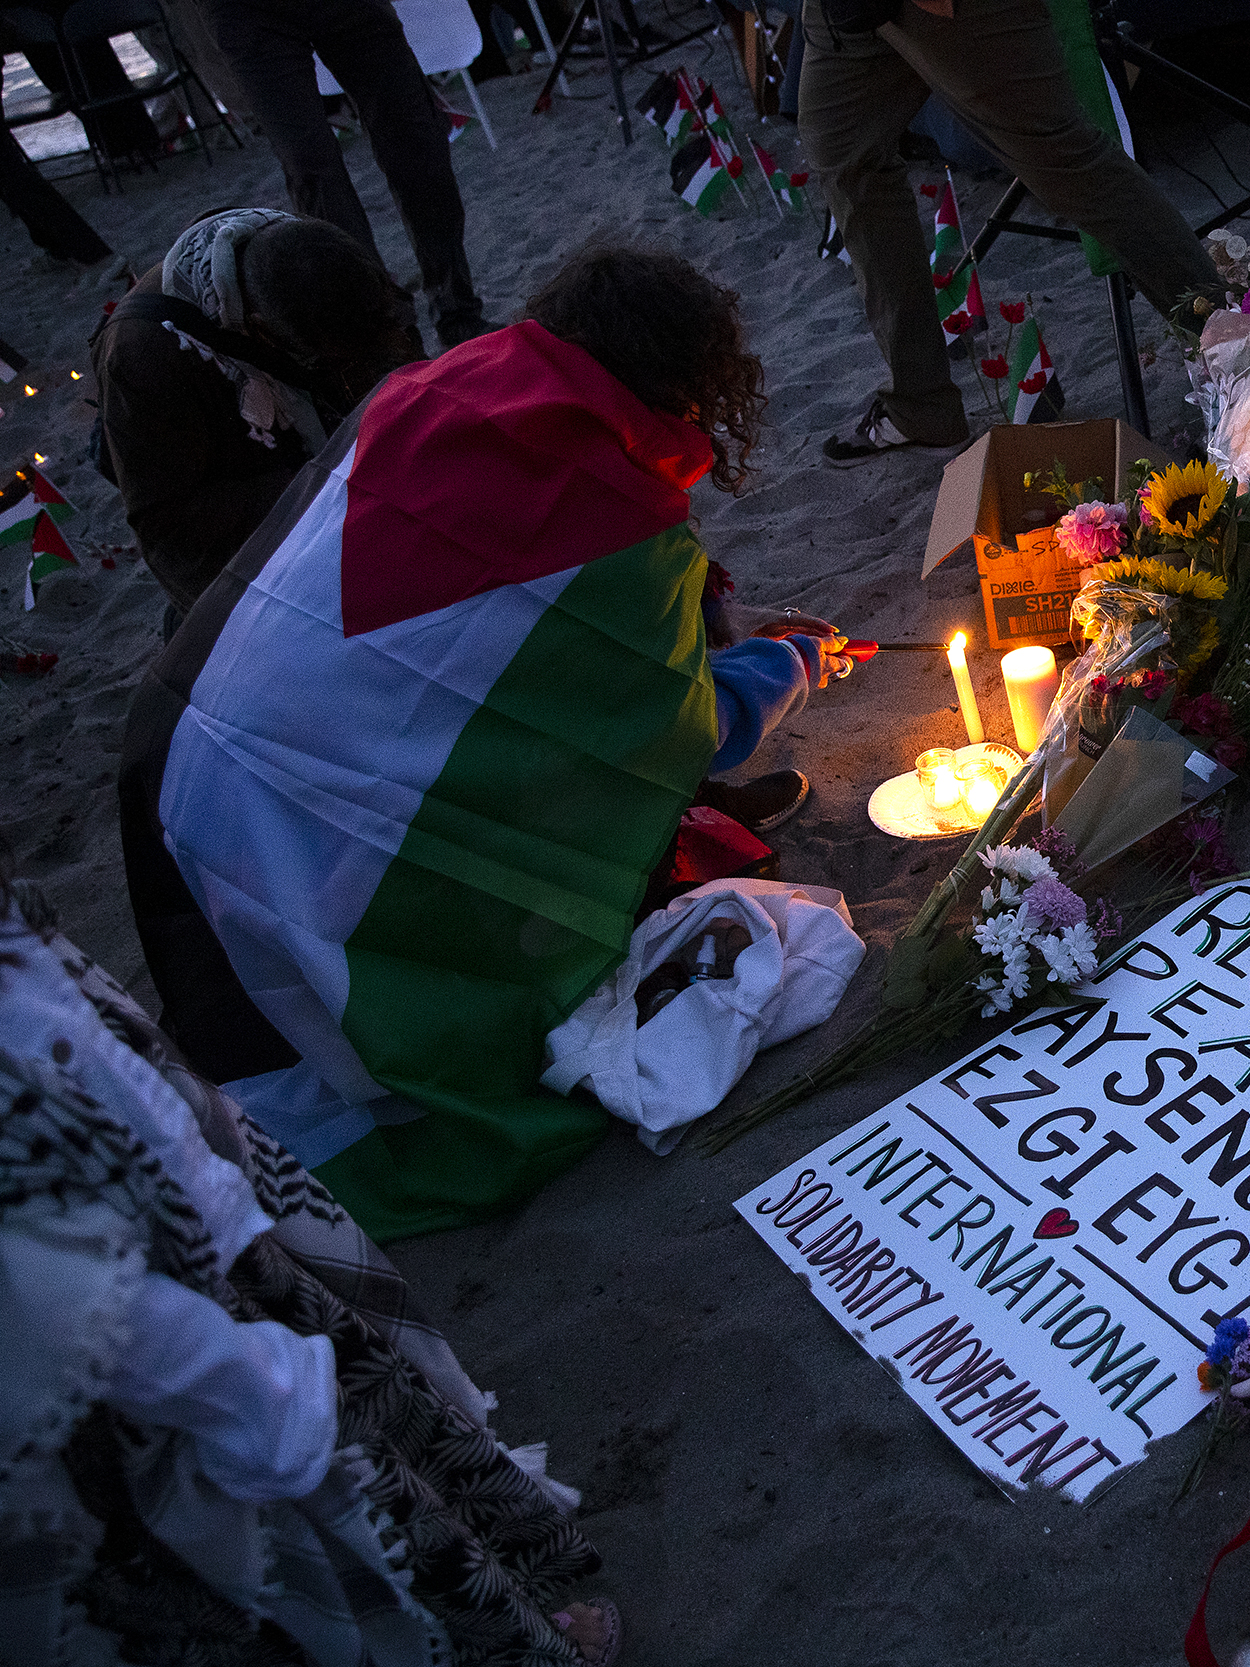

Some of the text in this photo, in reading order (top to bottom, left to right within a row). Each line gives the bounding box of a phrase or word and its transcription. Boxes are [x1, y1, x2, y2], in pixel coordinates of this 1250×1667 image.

[828, 1121, 1178, 1439] INTERNATIONAL
[940, 1043, 1137, 1199] EZGI
[756, 1168, 1122, 1488] SOLIDARITY MOVEMENT
